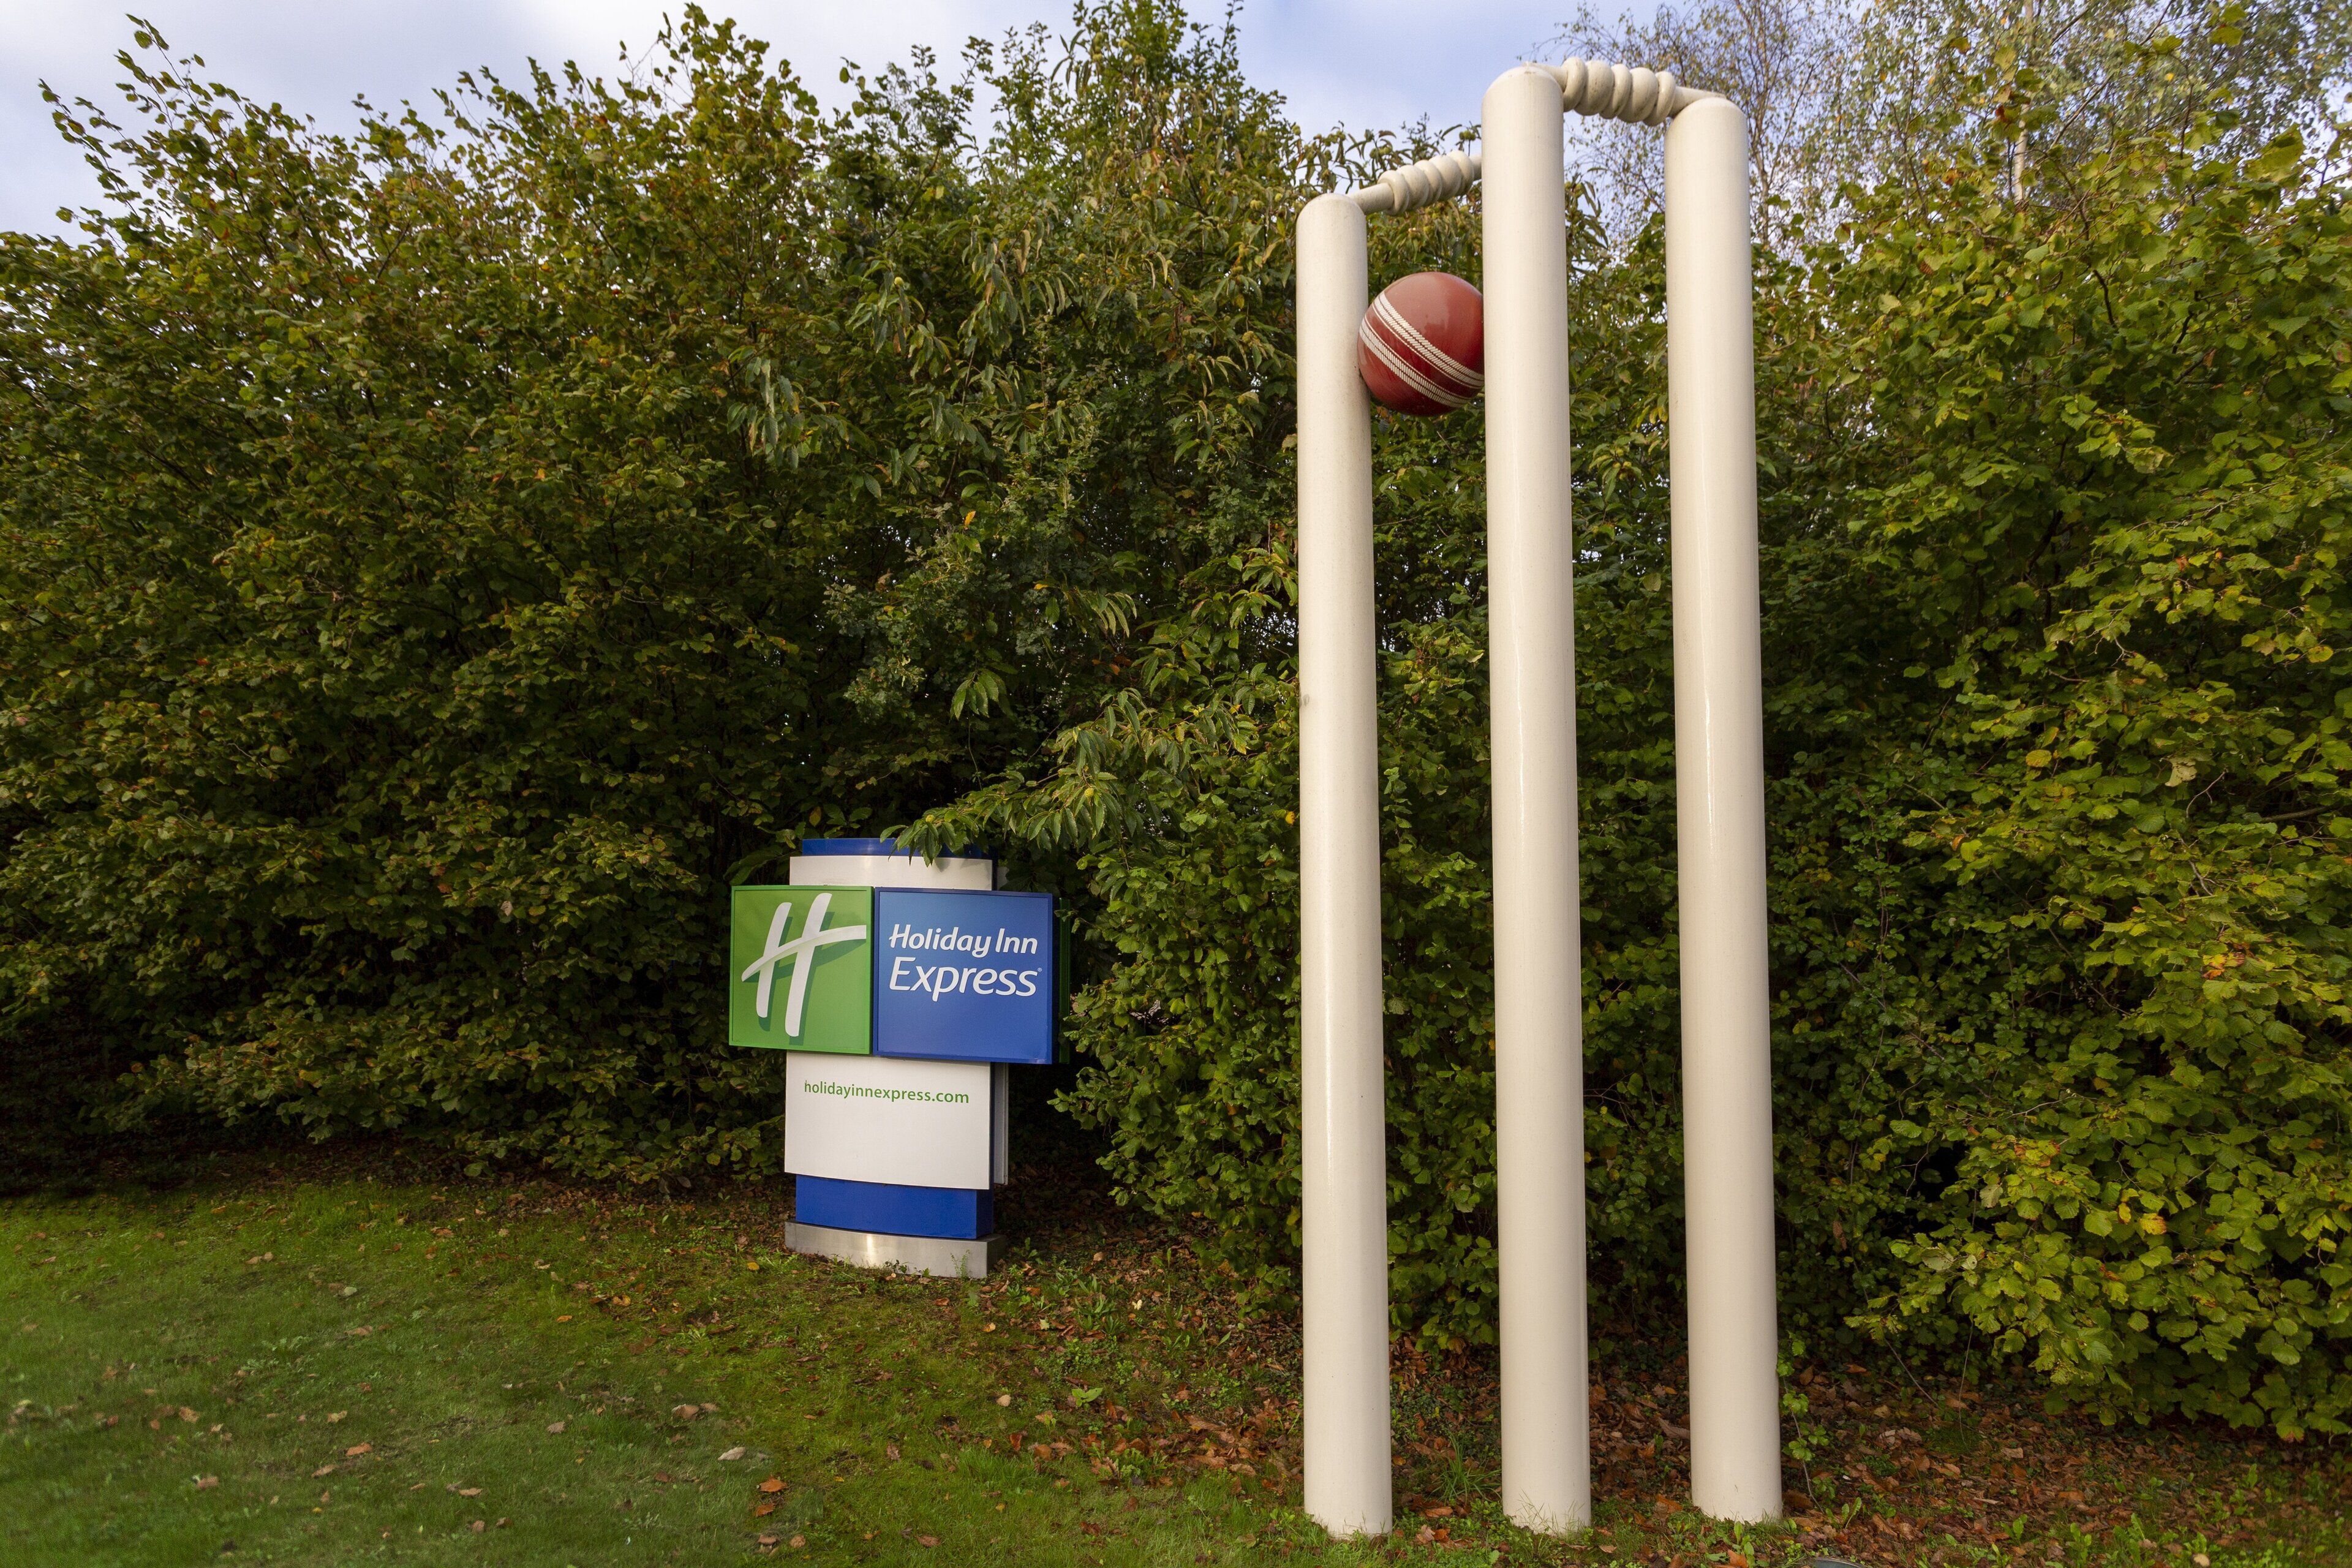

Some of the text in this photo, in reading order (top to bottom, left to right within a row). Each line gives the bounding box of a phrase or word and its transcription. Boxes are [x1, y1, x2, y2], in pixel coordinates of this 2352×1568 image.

[889, 924, 1038, 957] Holiday Inn
[889, 957, 1038, 1002] Express
[804, 1080, 969, 1103] holidayinnexpress.com
